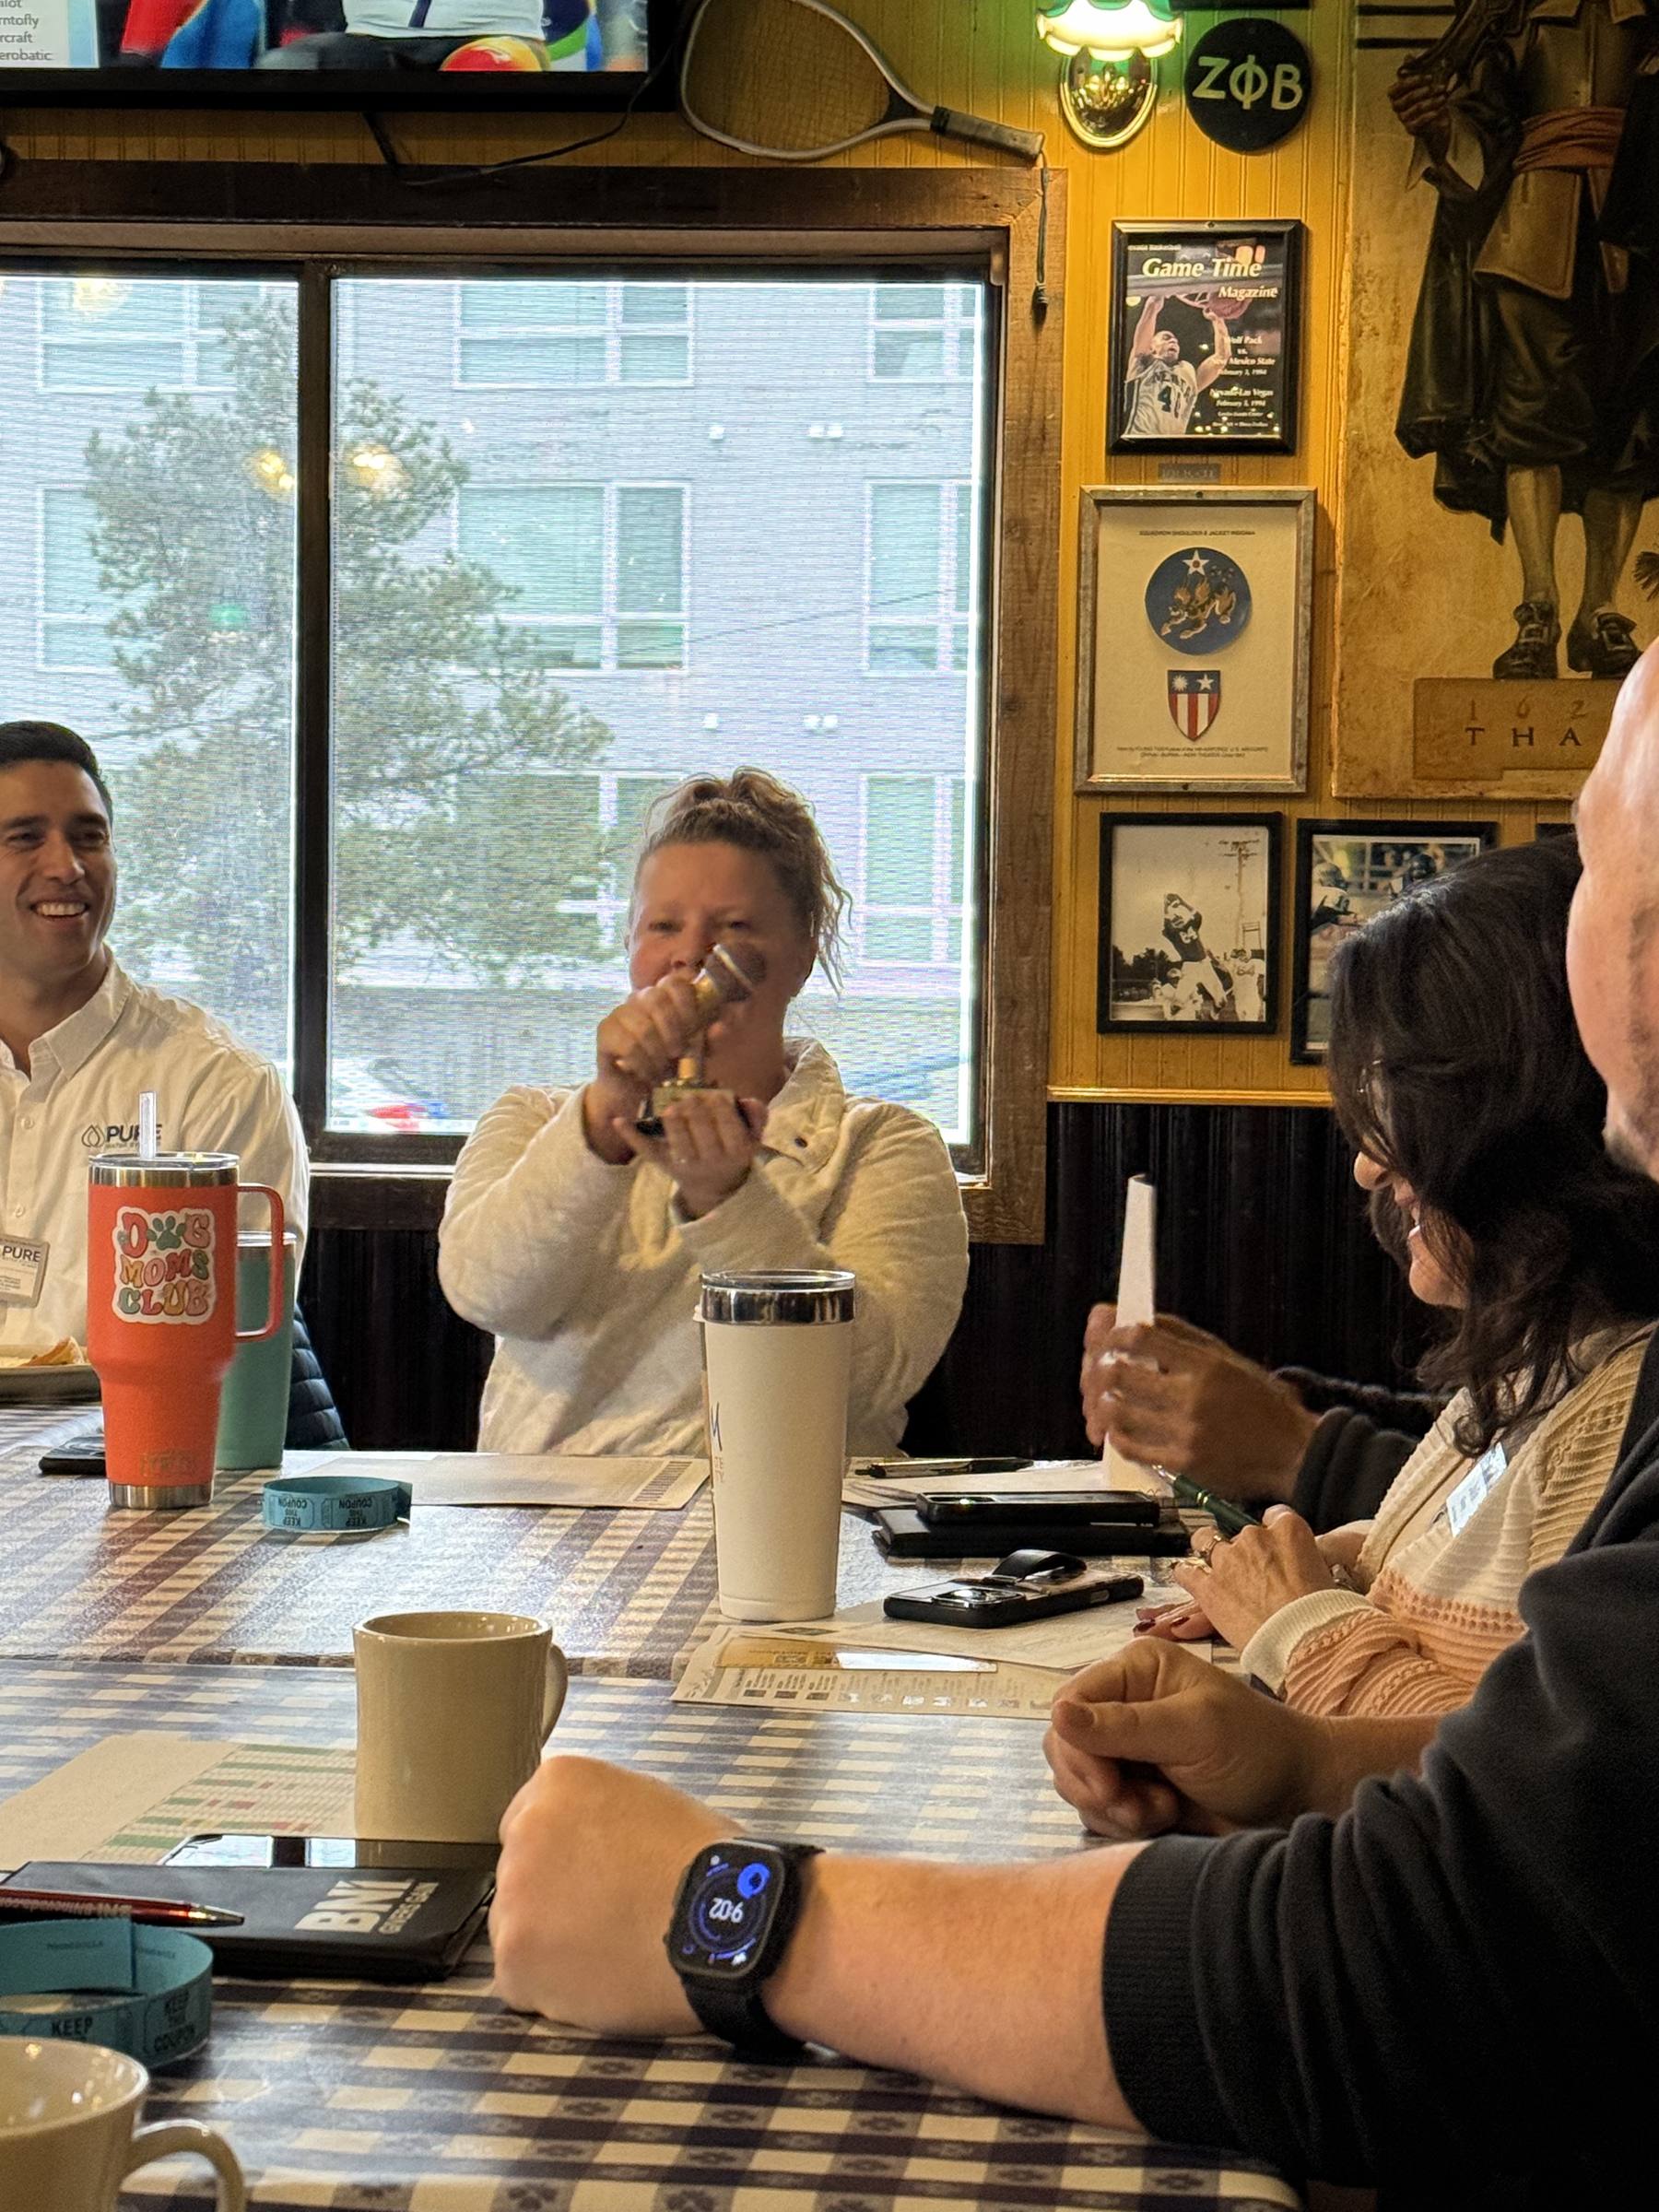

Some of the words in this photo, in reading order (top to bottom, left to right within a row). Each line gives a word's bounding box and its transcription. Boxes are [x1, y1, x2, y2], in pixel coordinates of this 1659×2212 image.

[0, 48, 53, 61] erobatic
[1142, 257, 1205, 277] Game
[1212, 257, 1263, 277] Time
[1218, 286, 1278, 301] Magazine
[1244, 336, 1263, 345] Pack
[1257, 357, 1276, 366] State
[2, 1245, 41, 1263] PURE
[120, 1248, 210, 1289] MOMS
[118, 1278, 209, 1317] CLUB
[338, 1497, 373, 1510] COUPON
[282, 1517, 301, 1527] KEEP
[51, 2016, 93, 2037] KEEP
